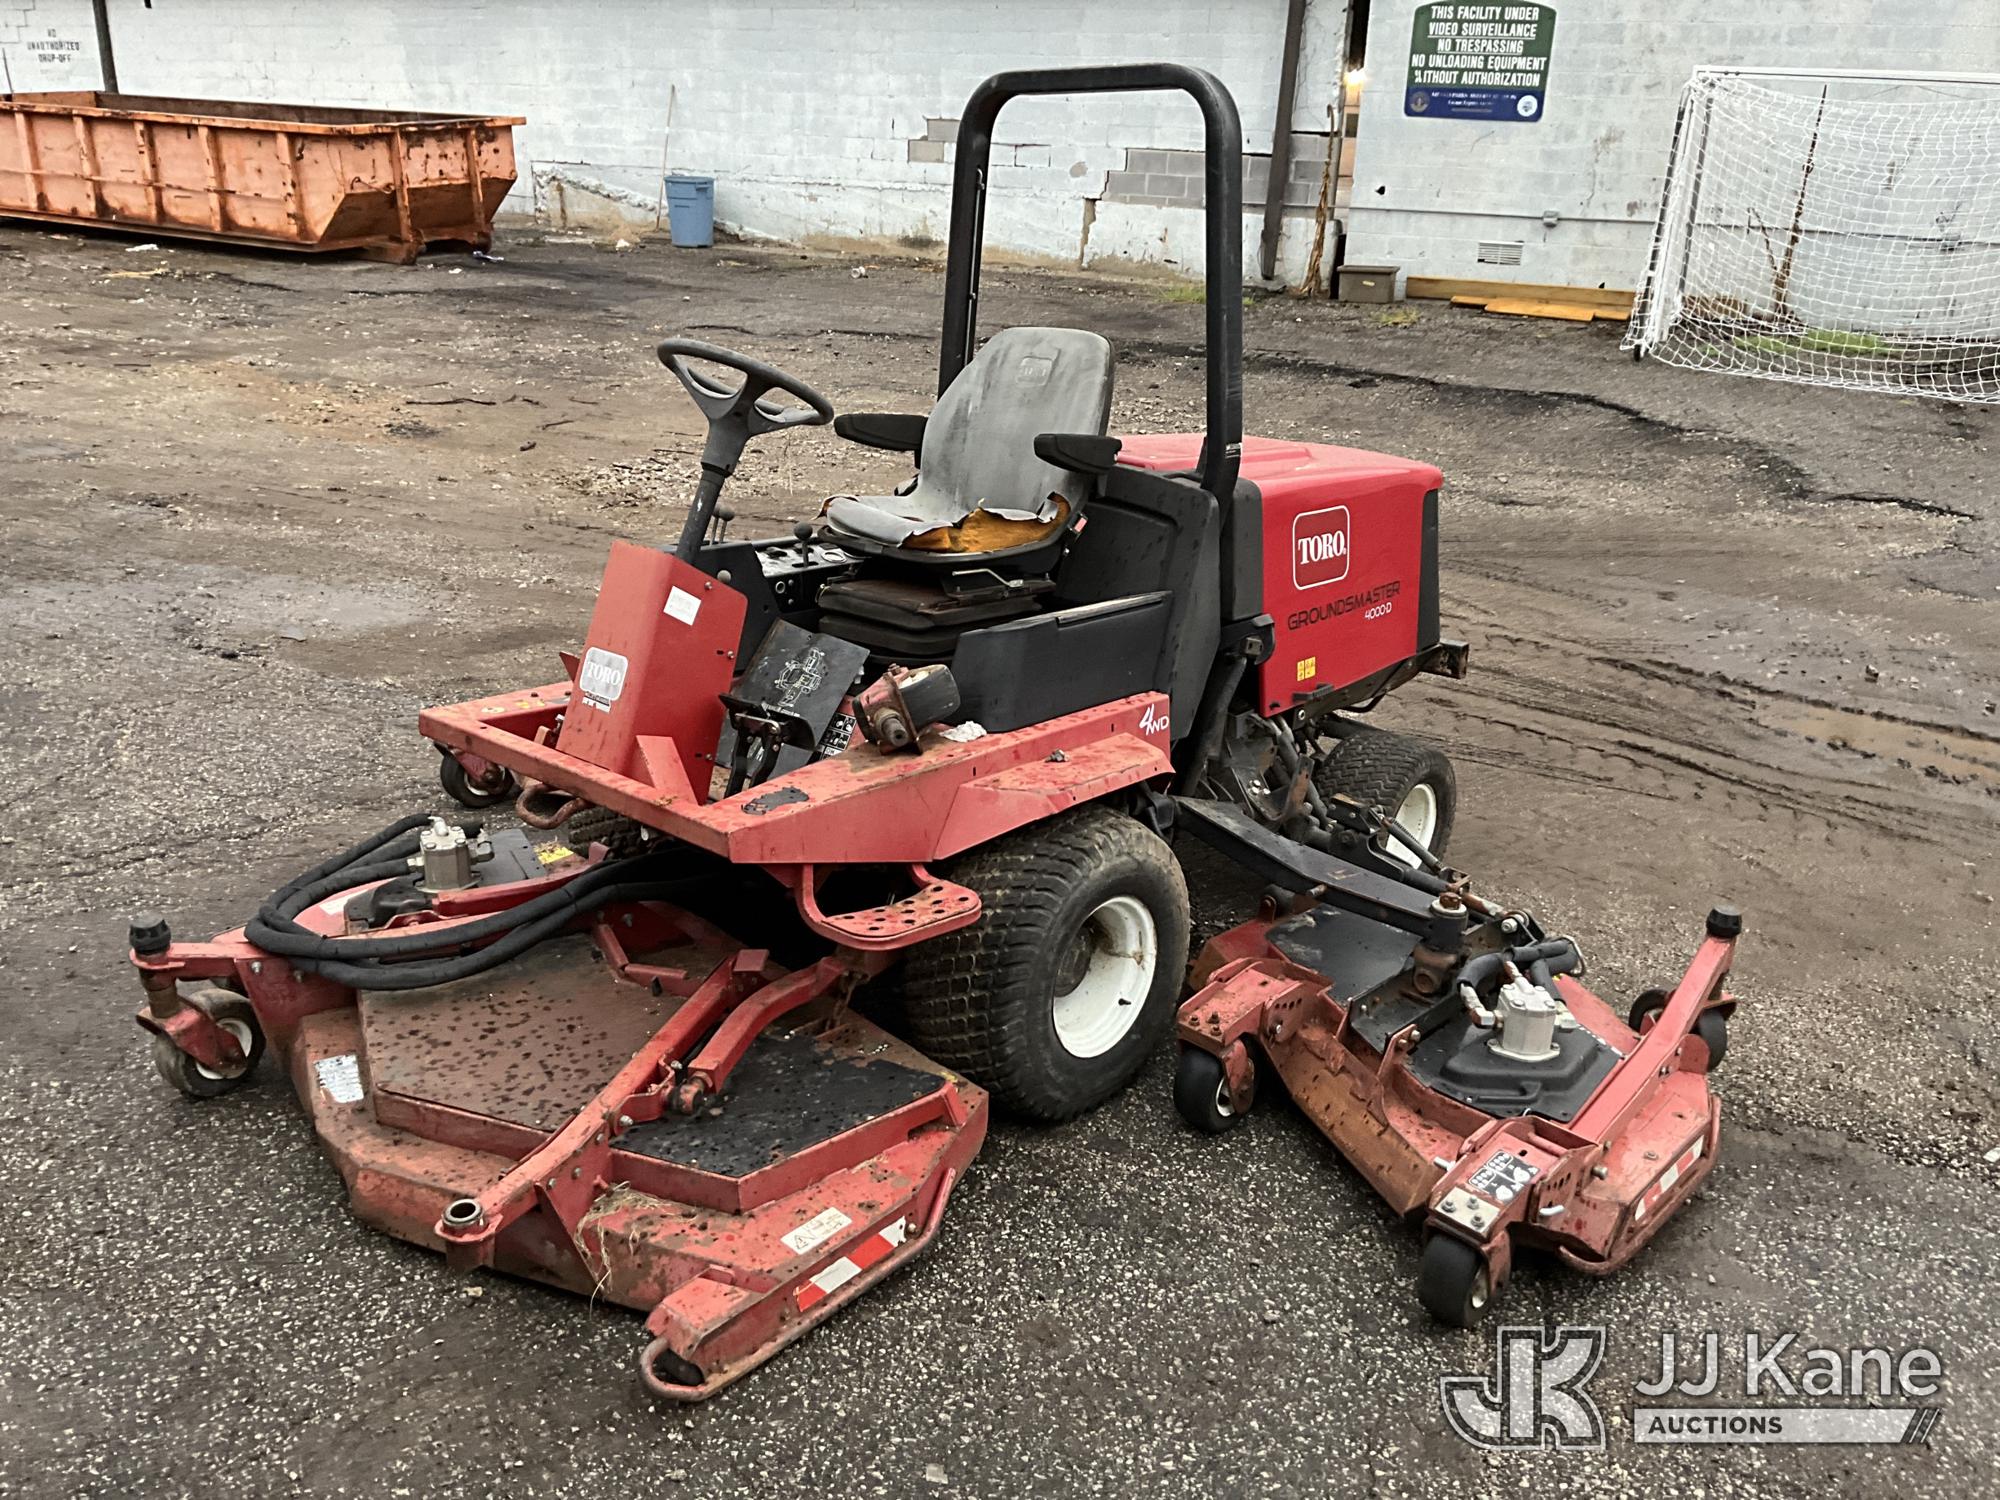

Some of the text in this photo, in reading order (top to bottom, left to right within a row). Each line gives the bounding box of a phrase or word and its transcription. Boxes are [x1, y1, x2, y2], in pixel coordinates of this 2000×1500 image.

[1431, 6, 1539, 20] THIS FACILITY UNDER
[1429, 22, 1538, 37] VIDEO SURVEILLANCE
[1437, 39, 1524, 53] NO TRESPASSING
[1411, 54, 1547, 71] NO UNLOADING EQUIPMENT
[1461, 71, 1540, 86] AUTHORIZATION
[1298, 530, 1346, 565] TORO
[1287, 581, 1401, 631] GROUNDSMASTER
[587, 661, 621, 685] TORO
